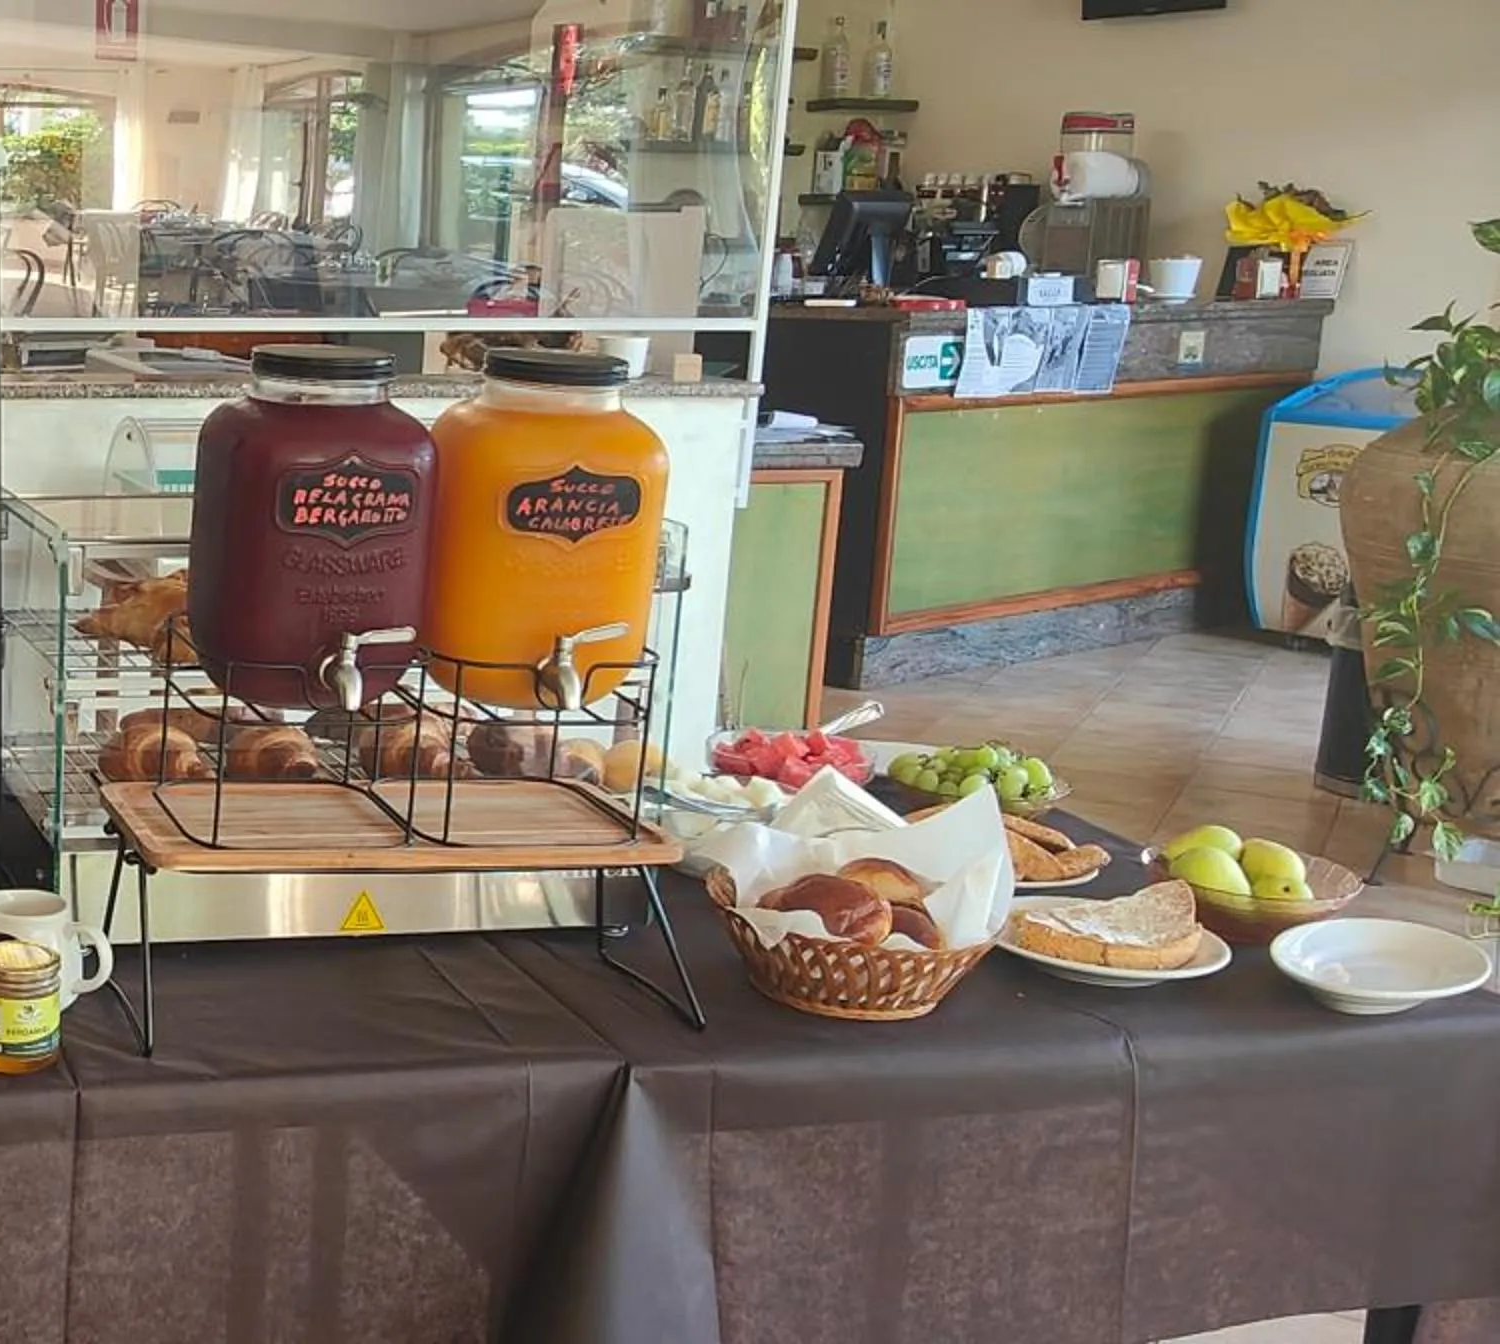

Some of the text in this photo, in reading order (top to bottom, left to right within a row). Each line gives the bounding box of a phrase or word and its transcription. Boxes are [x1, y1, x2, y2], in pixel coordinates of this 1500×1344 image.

[907, 355, 938, 370] USCITA
[322, 473, 382, 490] SUCCO
[549, 478, 616, 495] SUCCO
[516, 496, 620, 516] ARANCIA
